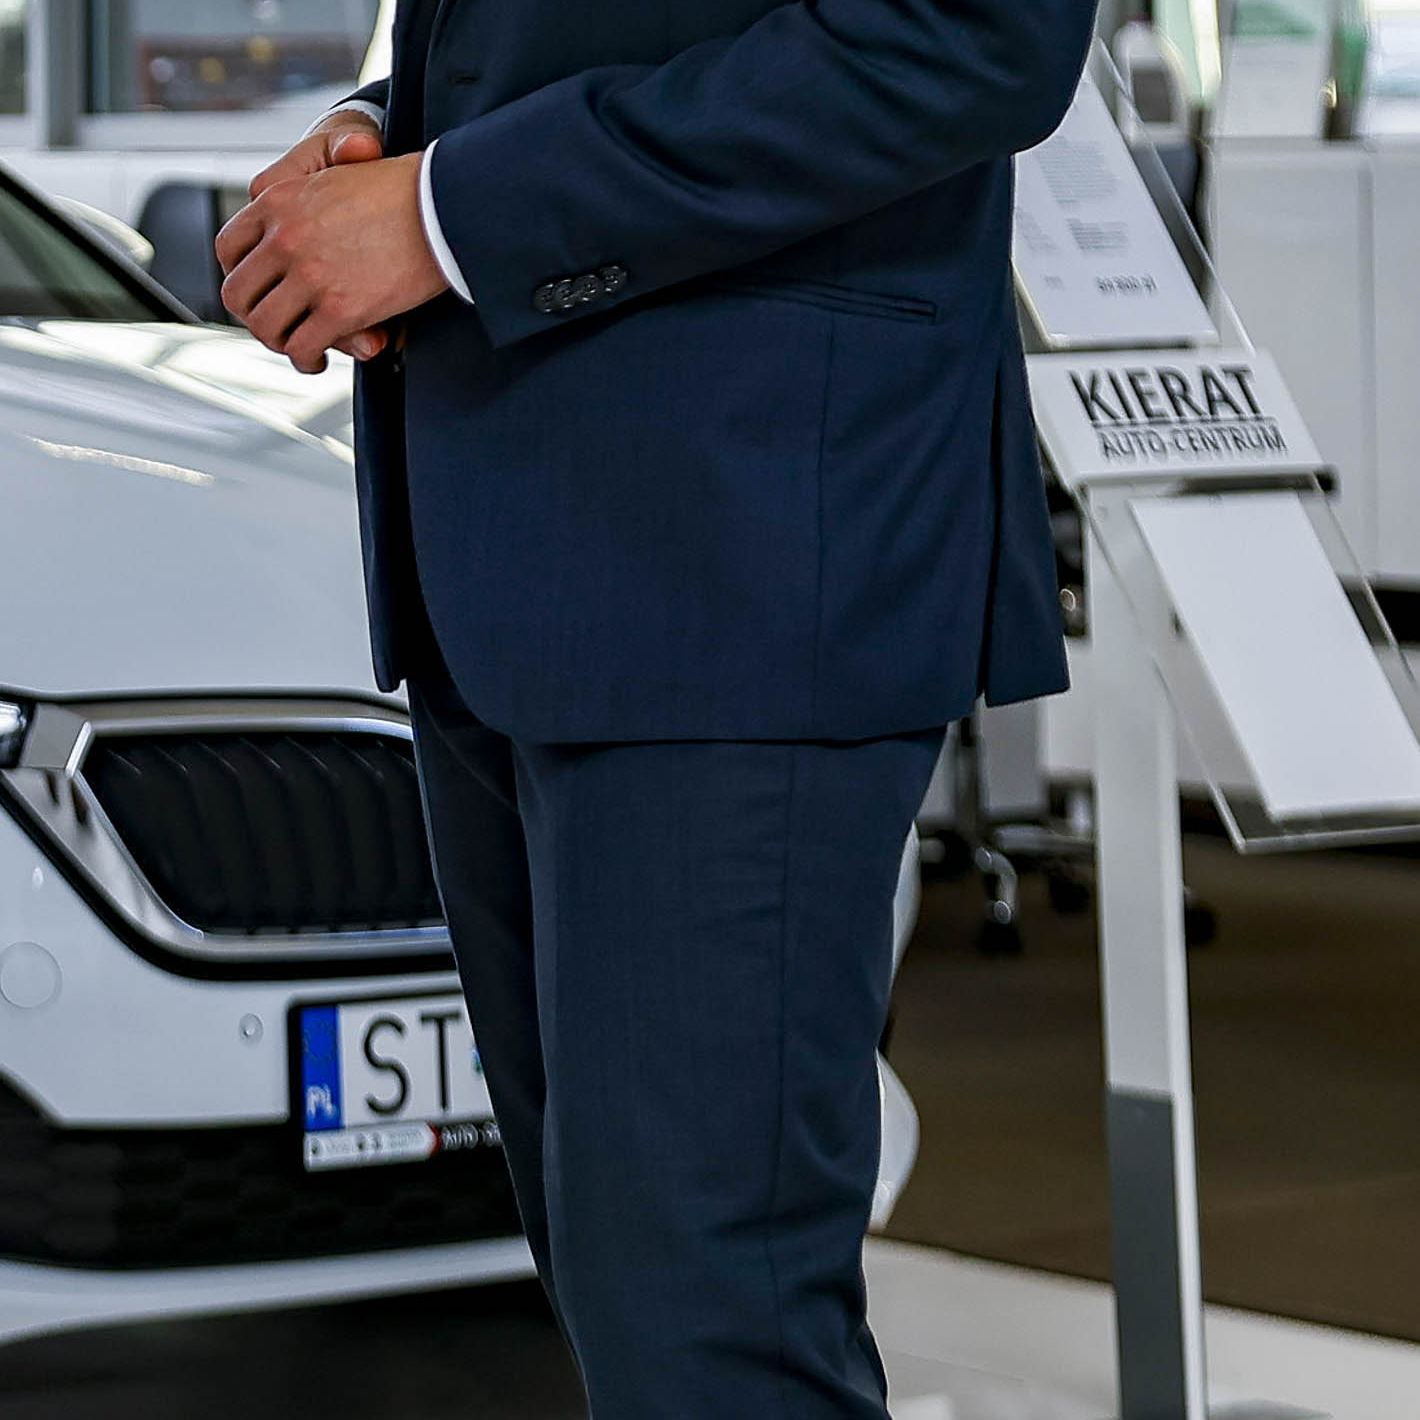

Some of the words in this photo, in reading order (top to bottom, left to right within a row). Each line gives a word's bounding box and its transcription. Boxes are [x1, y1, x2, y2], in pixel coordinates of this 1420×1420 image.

[1068, 365, 1264, 422] KIERAT
[364, 1009, 461, 1116] ST
[307, 1084, 336, 1117] PL
